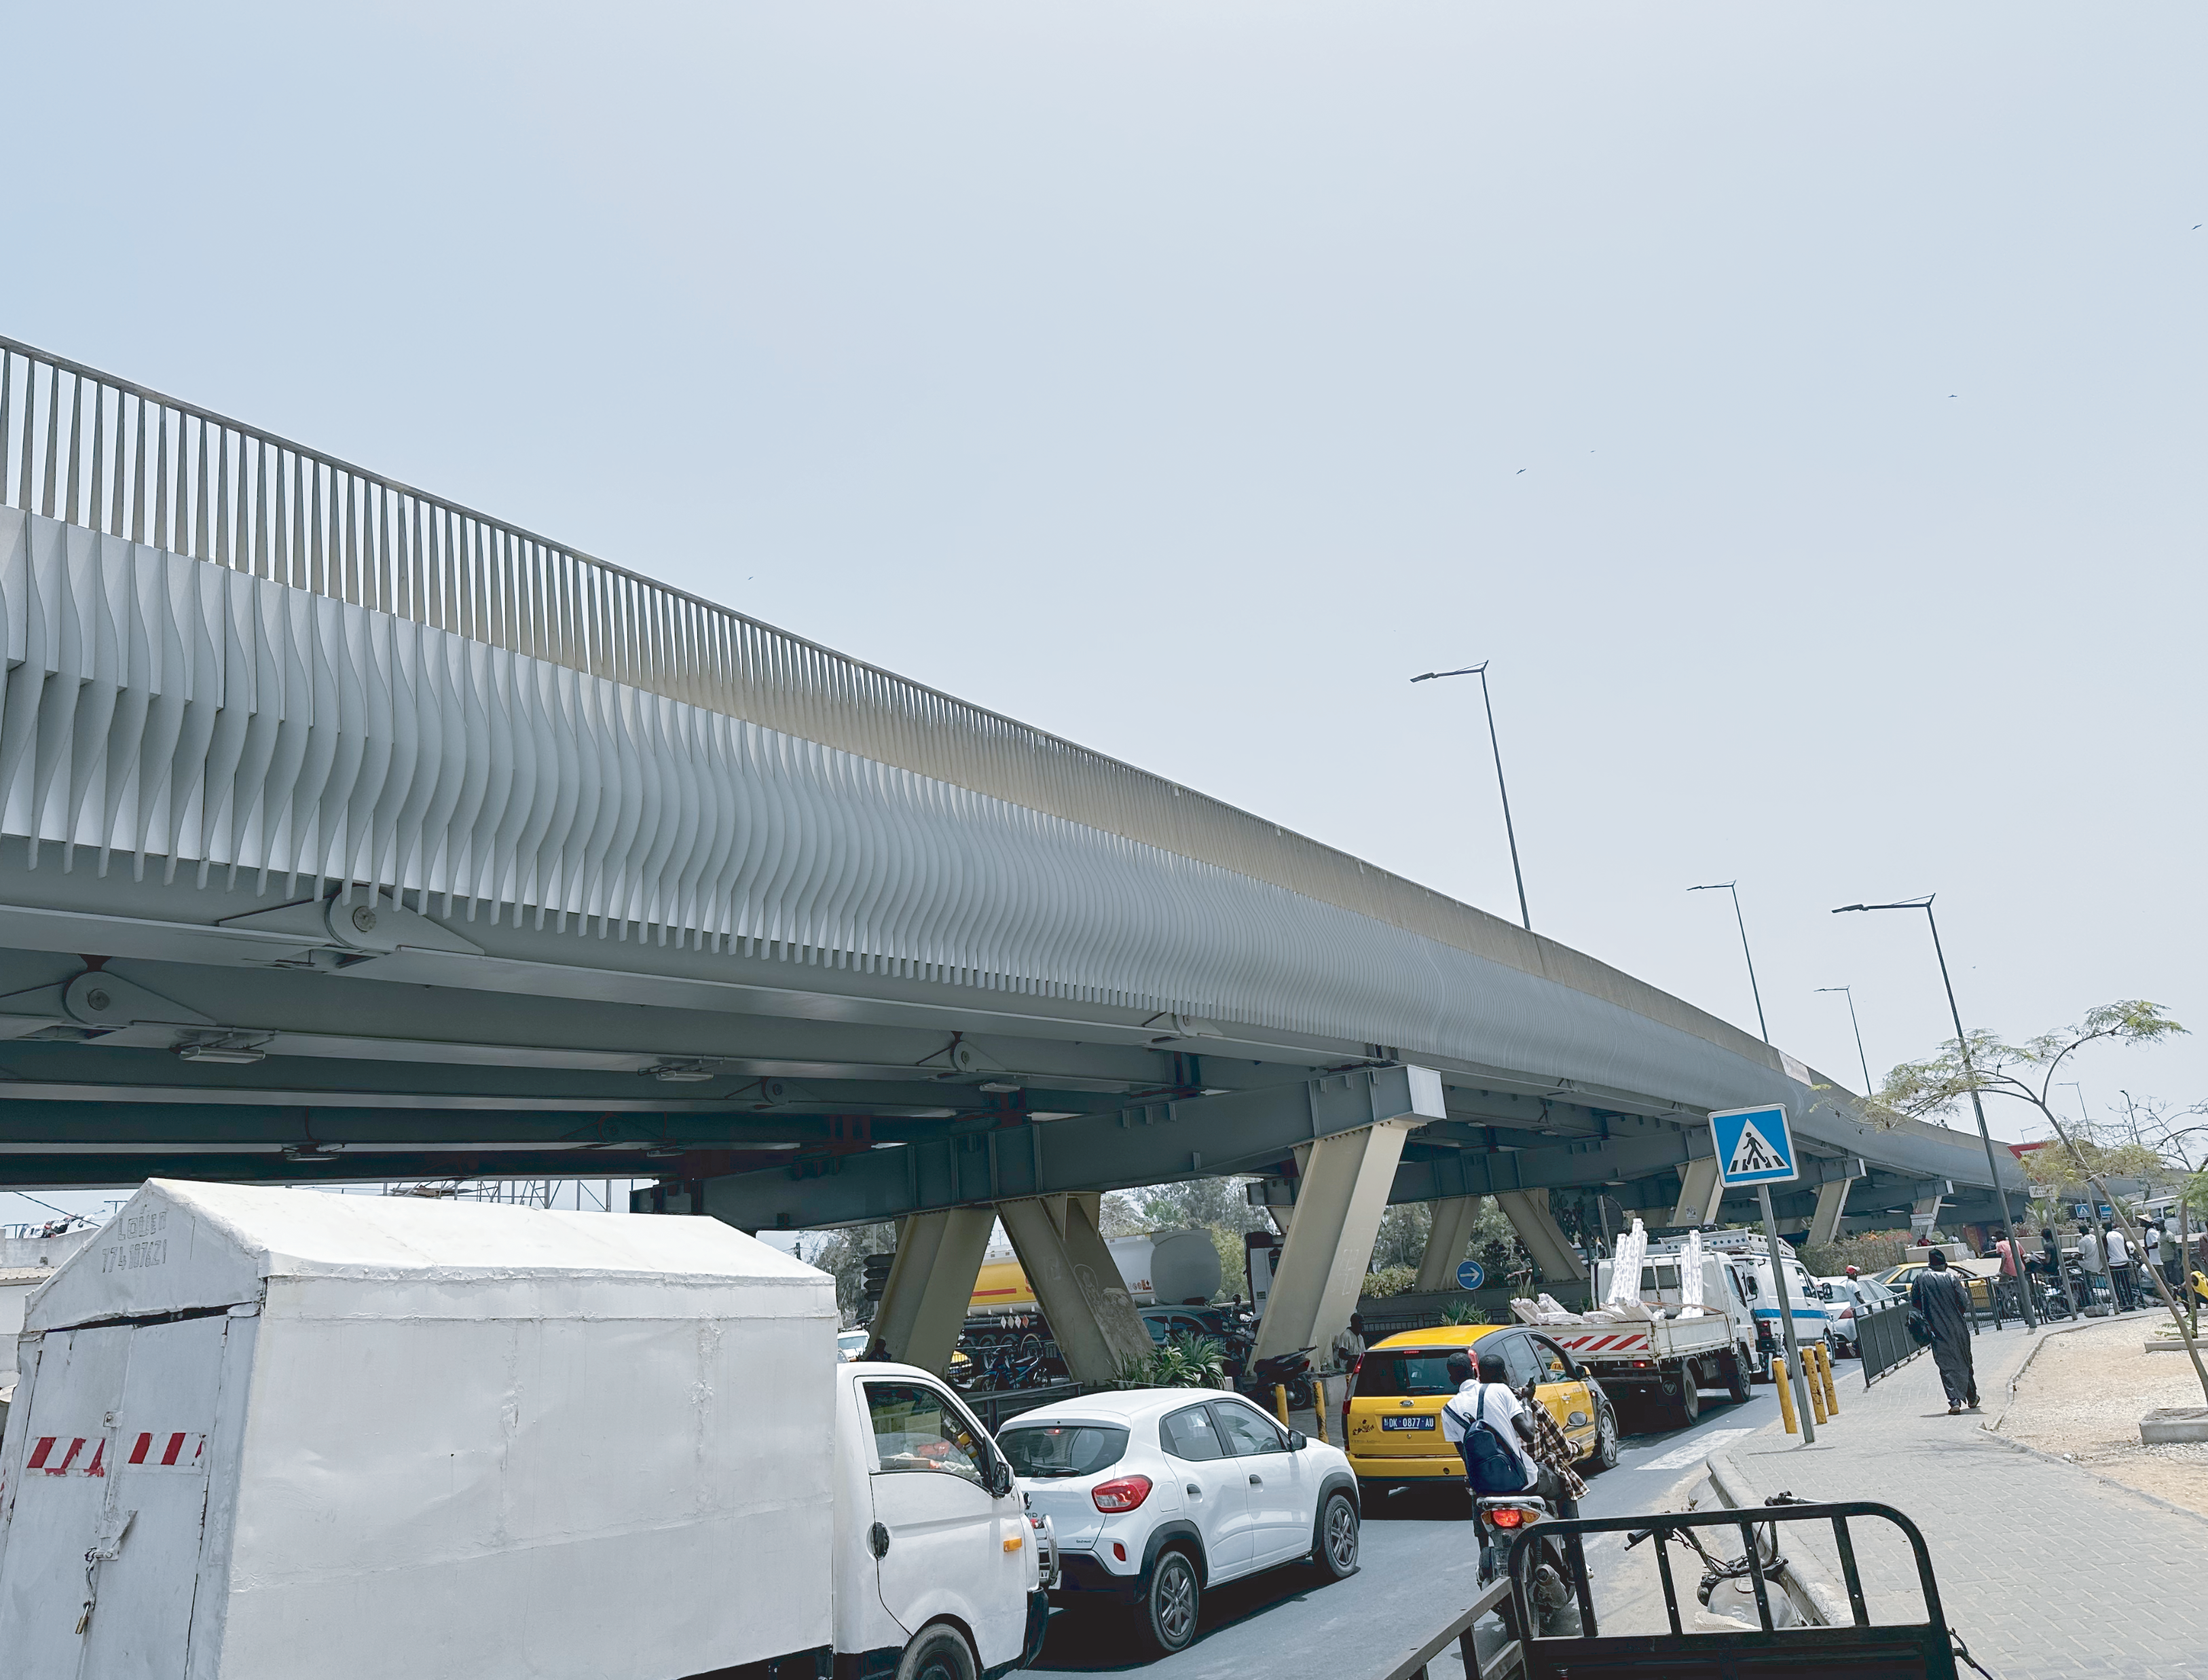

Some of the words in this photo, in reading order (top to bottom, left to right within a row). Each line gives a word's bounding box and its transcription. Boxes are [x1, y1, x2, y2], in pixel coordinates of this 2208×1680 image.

[1388, 1418, 1398, 1427] DK
[1402, 1418, 1421, 1427] 0877
[1425, 1417, 1434, 1427] AU
